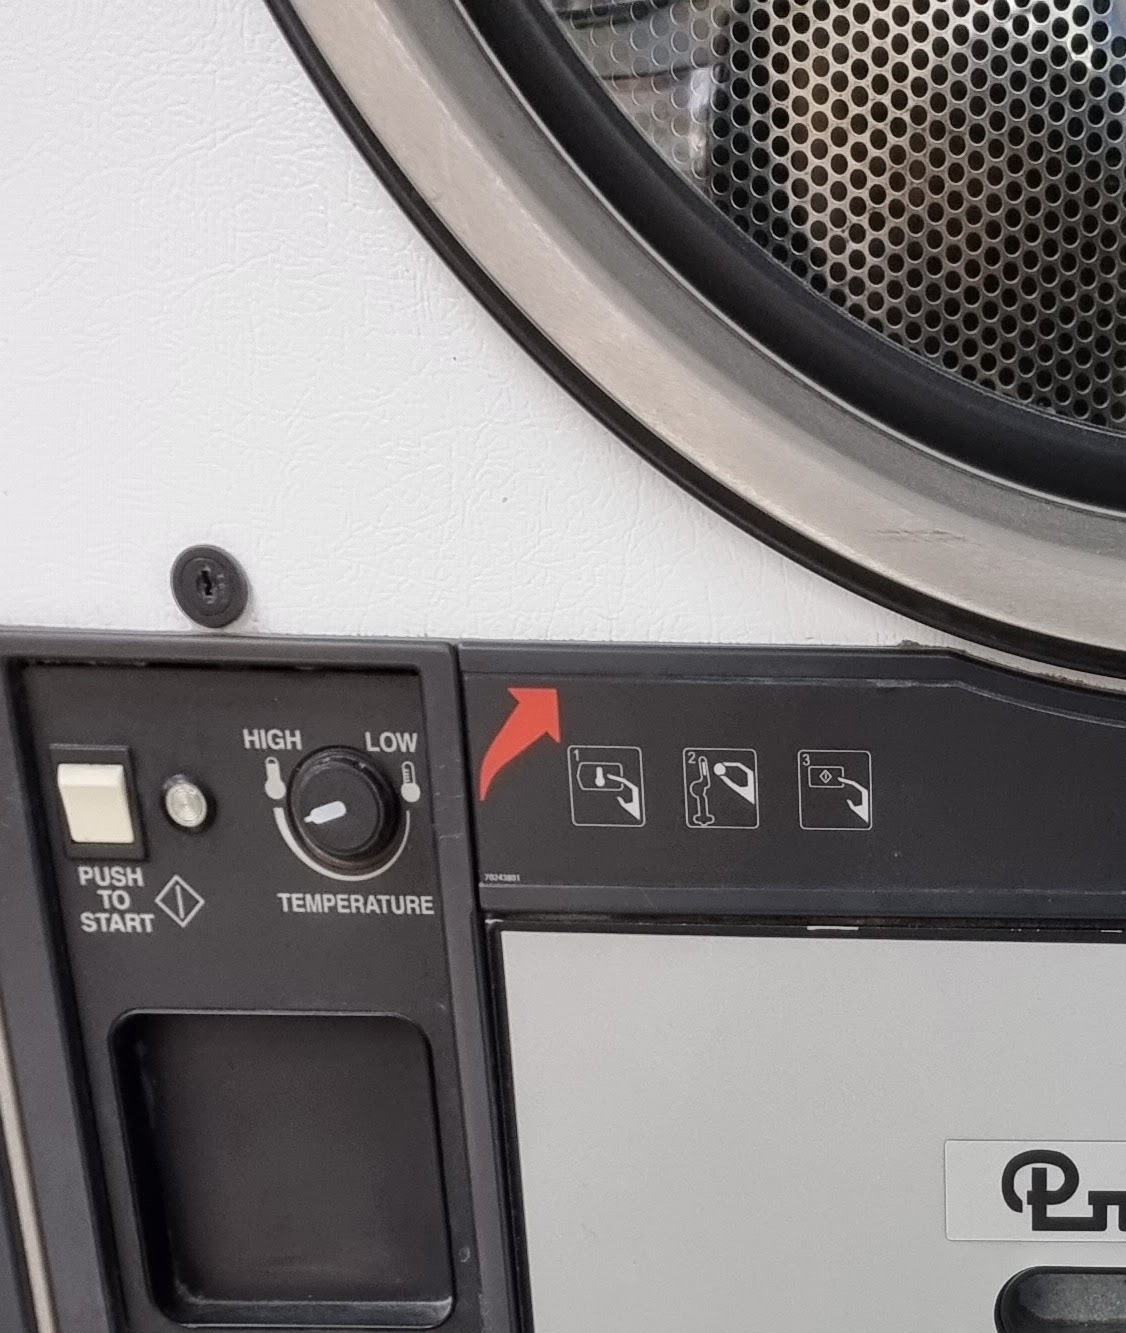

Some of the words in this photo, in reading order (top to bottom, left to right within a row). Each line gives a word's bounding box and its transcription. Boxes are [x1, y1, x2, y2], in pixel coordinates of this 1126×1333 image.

[243, 728, 303, 751] HIGH
[365, 731, 418, 753] LOW
[573, 748, 580, 762] 1
[687, 751, 697, 765] 2
[802, 753, 812, 767] 3
[77, 865, 145, 888] PUSH
[96, 889, 131, 910] TO
[276, 892, 435, 915] TEMPERATURE
[80, 911, 155, 934] START
